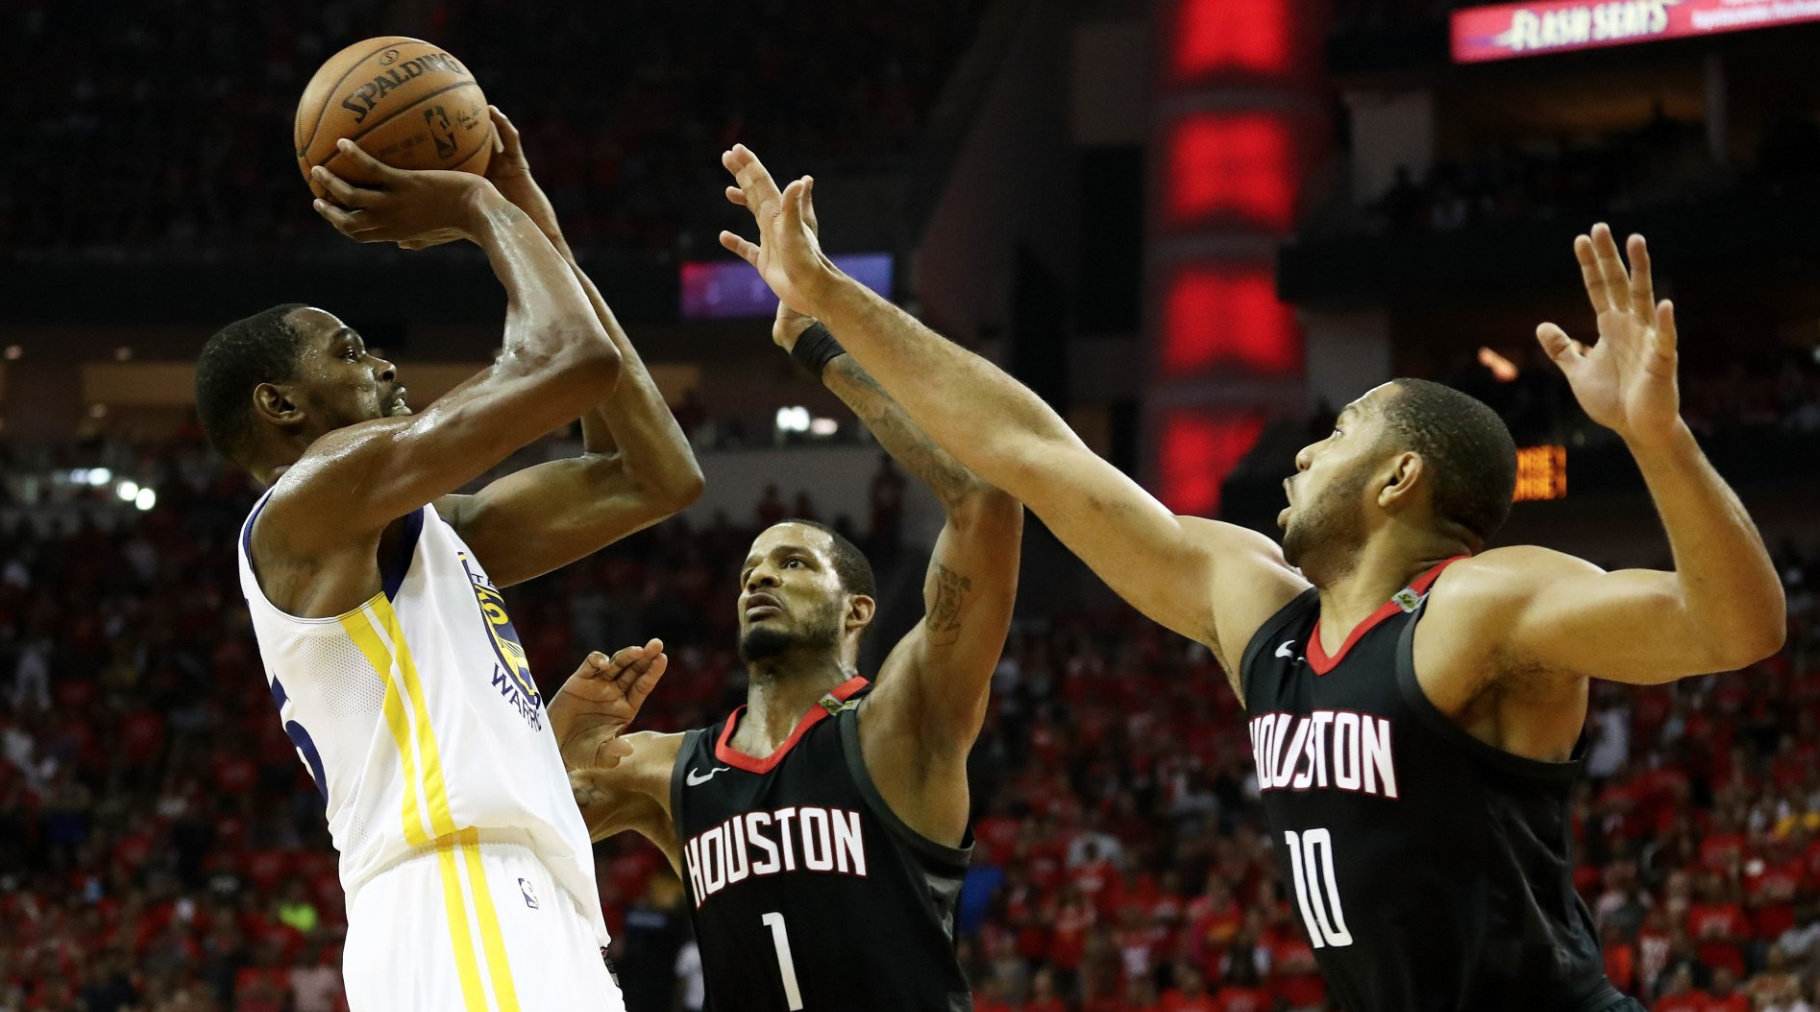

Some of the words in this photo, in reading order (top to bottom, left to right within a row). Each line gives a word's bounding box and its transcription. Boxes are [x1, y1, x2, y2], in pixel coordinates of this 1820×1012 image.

[341, 52, 466, 124] SPALDING
[684, 806, 867, 909] HOUSTON
[1284, 827, 1354, 949] 10
[761, 911, 804, 1012] 1
